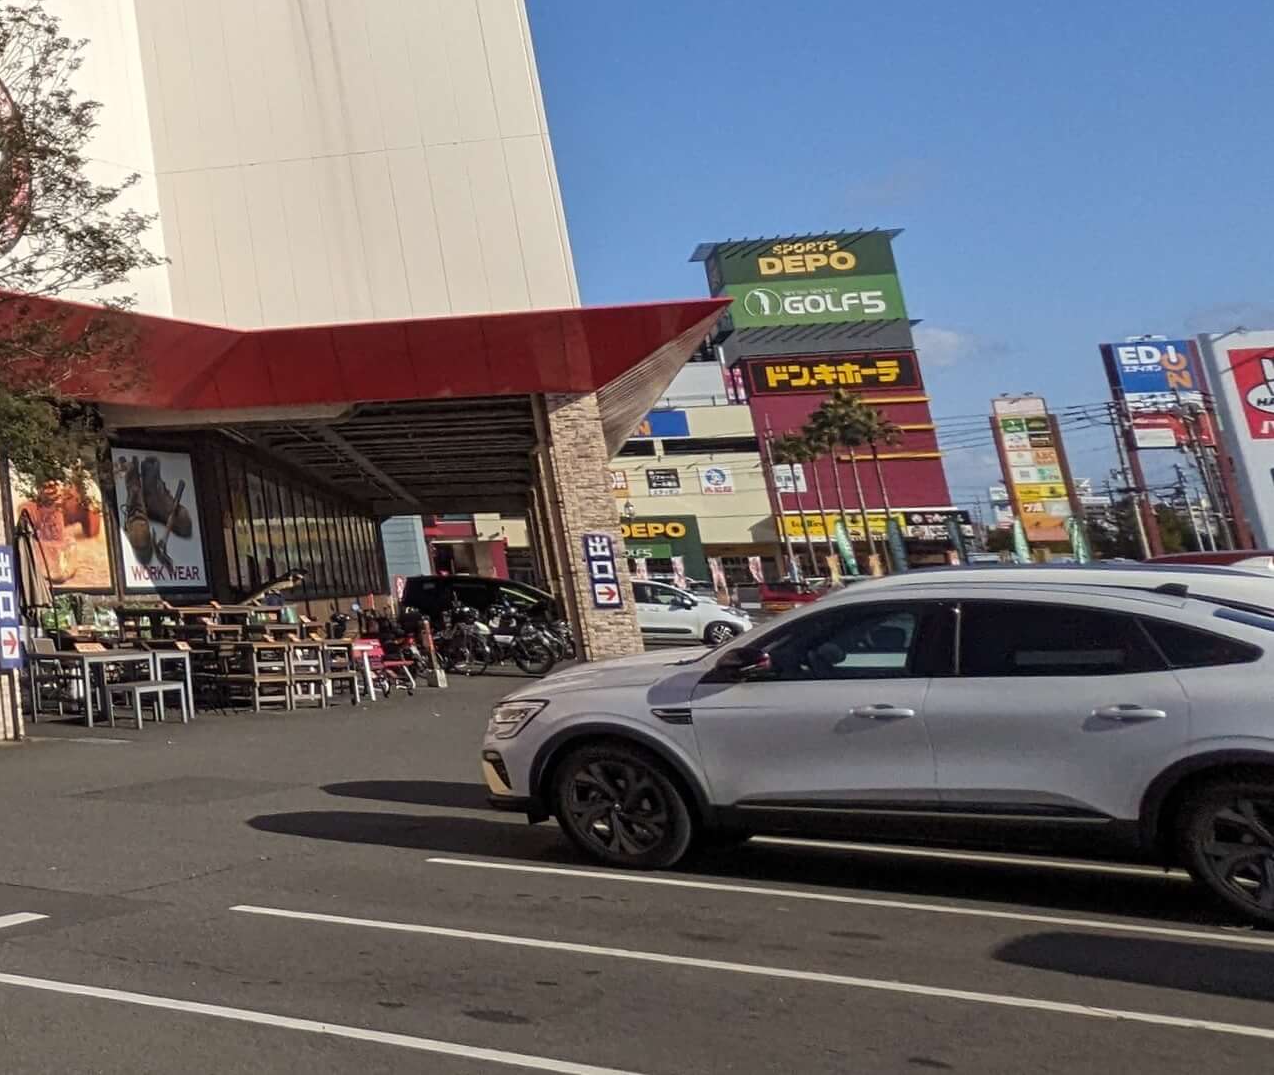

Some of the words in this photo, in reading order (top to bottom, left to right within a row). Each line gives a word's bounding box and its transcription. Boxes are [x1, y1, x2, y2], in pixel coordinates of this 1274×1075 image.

[772, 240, 838, 255] SPORTS
[758, 252, 856, 275] DEPO
[783, 291, 886, 314] GOLF5
[588, 537, 615, 579] 出口
[131, 565, 165, 581] WORK
[167, 565, 200, 581] WEAR
